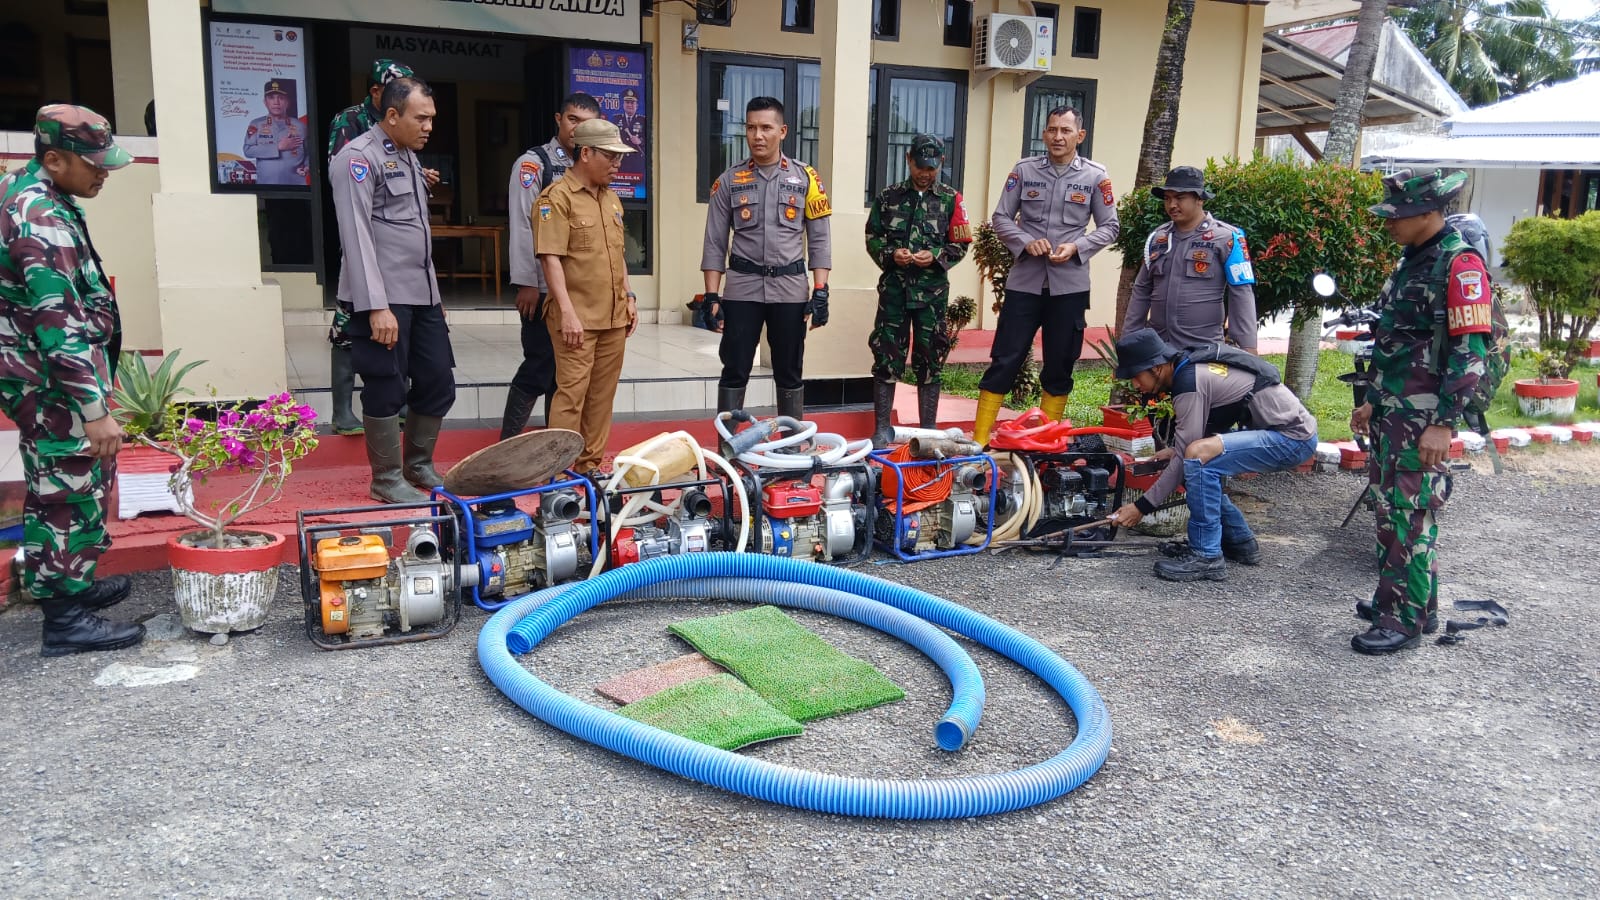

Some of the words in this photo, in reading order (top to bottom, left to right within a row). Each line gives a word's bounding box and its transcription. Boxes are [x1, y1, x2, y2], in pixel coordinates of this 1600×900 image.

[375, 34, 504, 58] MASYARAKAT
[605, 98, 620, 110] 110
[780, 183, 806, 194] POLRI
[1066, 183, 1092, 194] POLRI
[1191, 241, 1216, 249] POLRI
